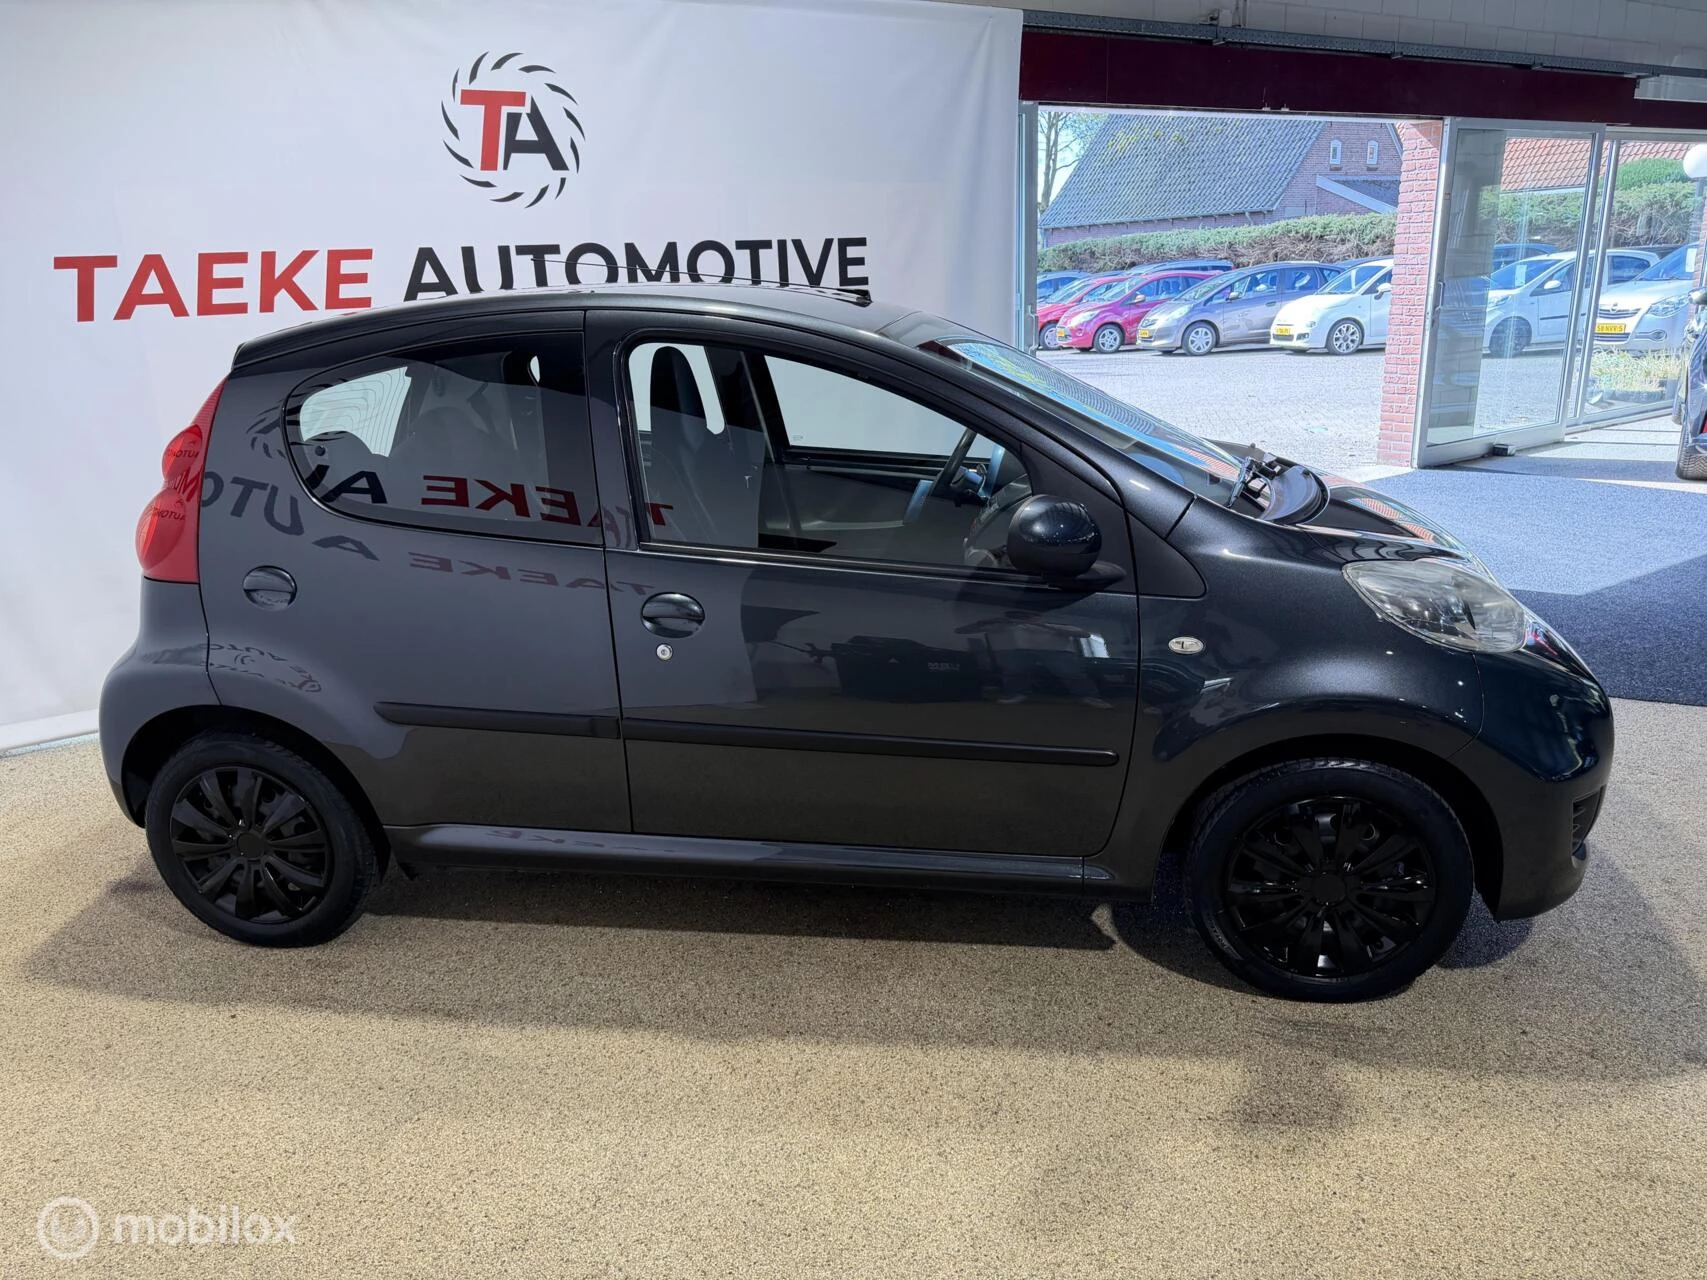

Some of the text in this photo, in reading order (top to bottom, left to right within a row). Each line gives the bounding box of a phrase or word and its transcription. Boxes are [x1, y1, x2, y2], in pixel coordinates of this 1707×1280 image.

[460, 89, 569, 171] TA
[53, 237, 869, 322] TAEKE AUTOMOTIVE
